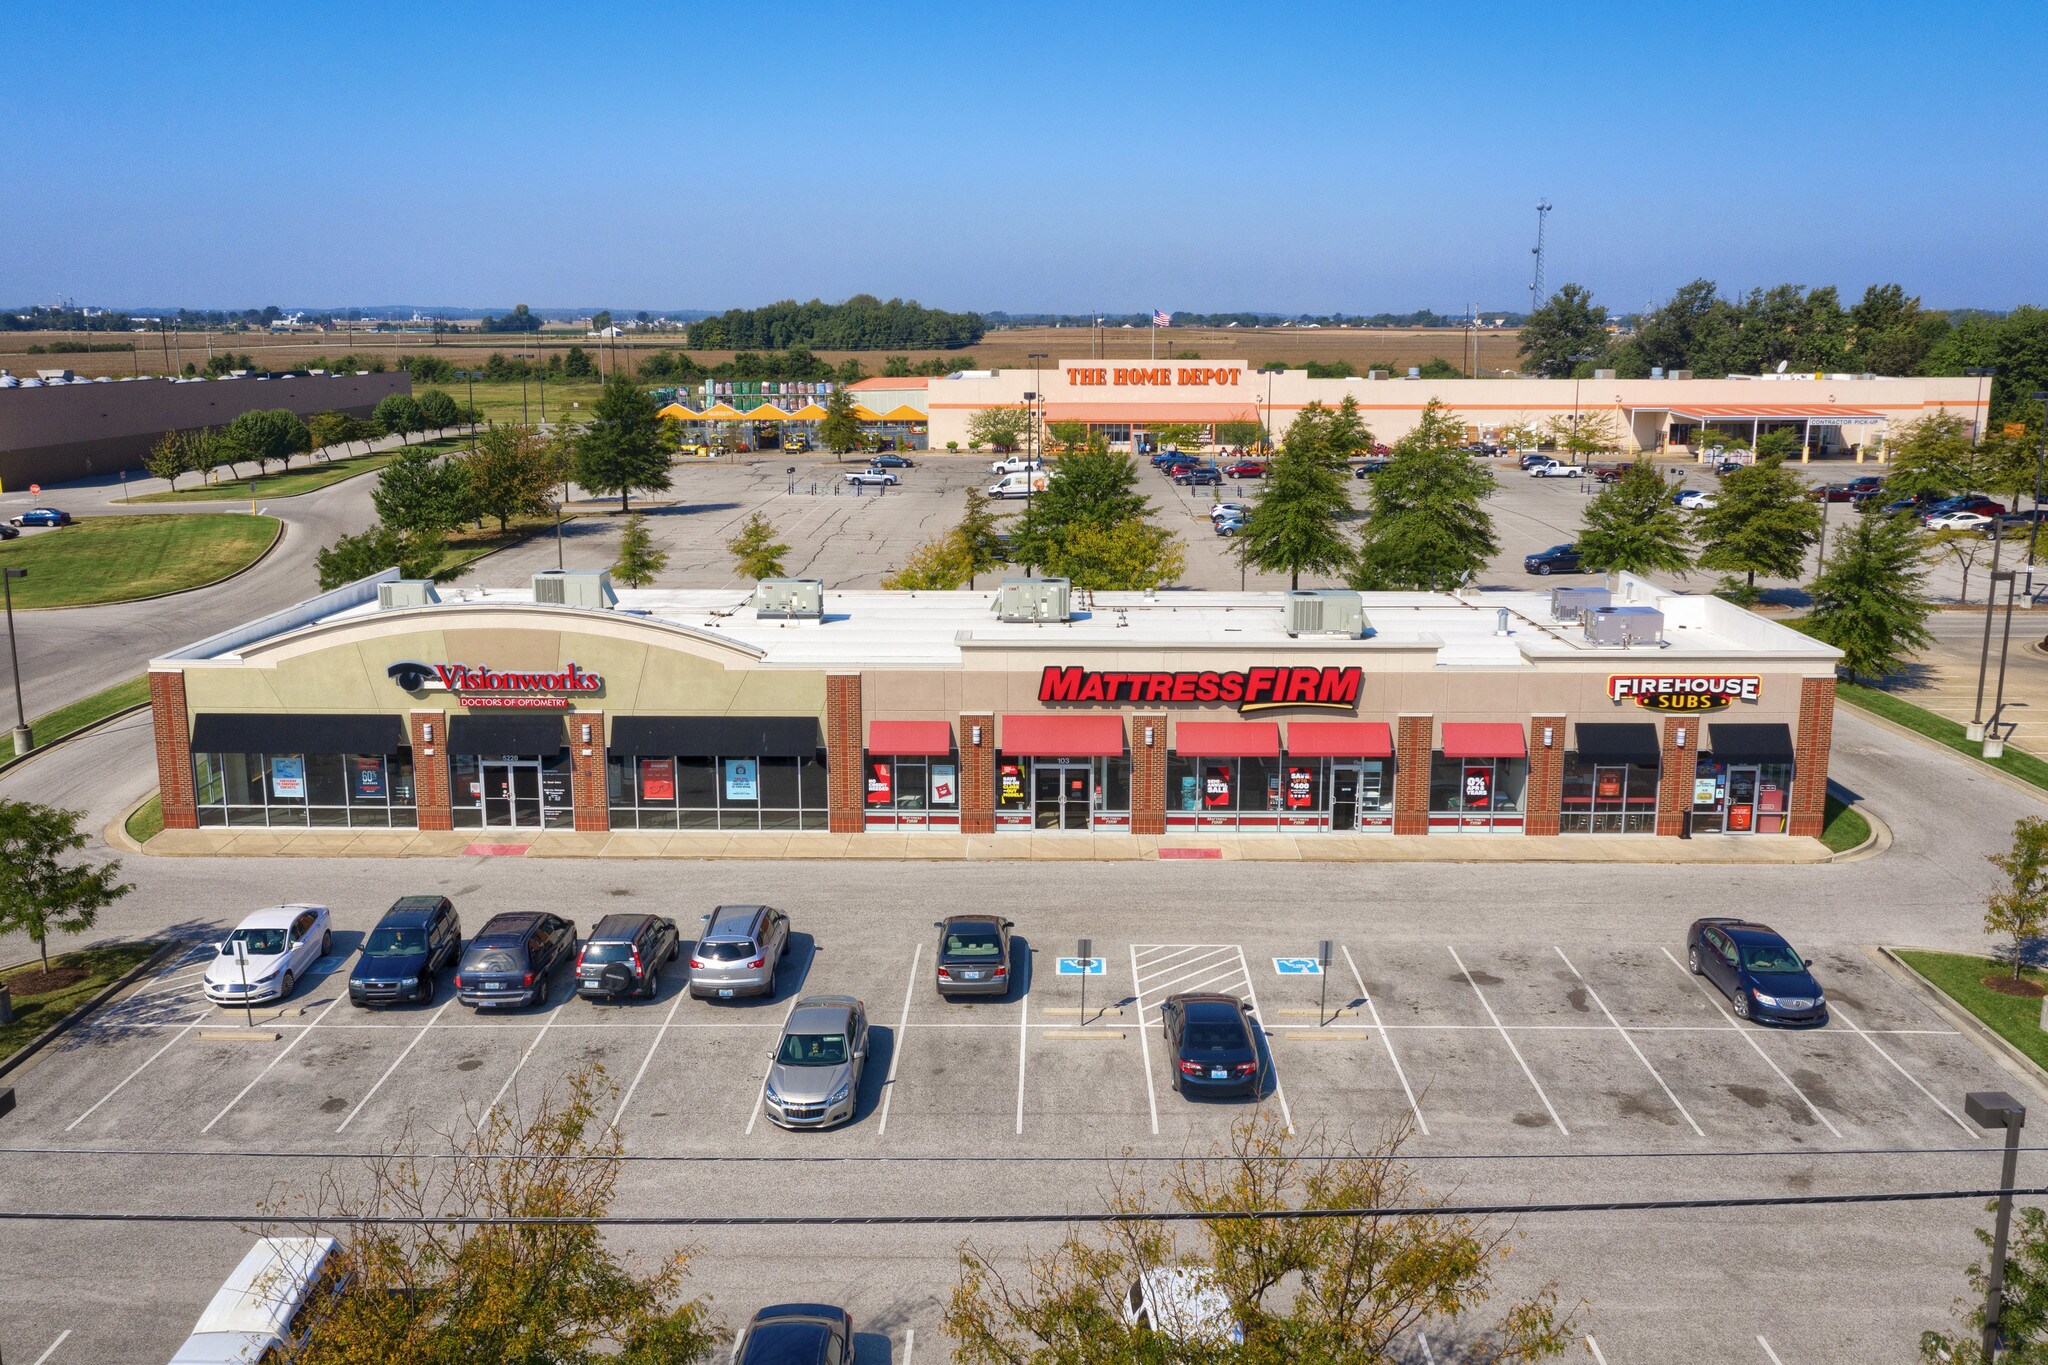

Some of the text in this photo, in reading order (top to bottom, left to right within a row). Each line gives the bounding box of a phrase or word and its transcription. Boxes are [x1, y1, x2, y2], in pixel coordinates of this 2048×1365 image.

[1066, 367, 1241, 386] THE HOME DEPOT
[434, 662, 599, 691] Visionworks
[1038, 666, 1363, 702] MATTRESS FIRM
[1613, 678, 1759, 701] FIREHOUSE
[461, 698, 566, 707] DOCTORS OF OPTOMETRY
[1658, 694, 1712, 708] SUBS
[361, 770, 378, 782] 60%
[1466, 776, 1485, 786] 0%
